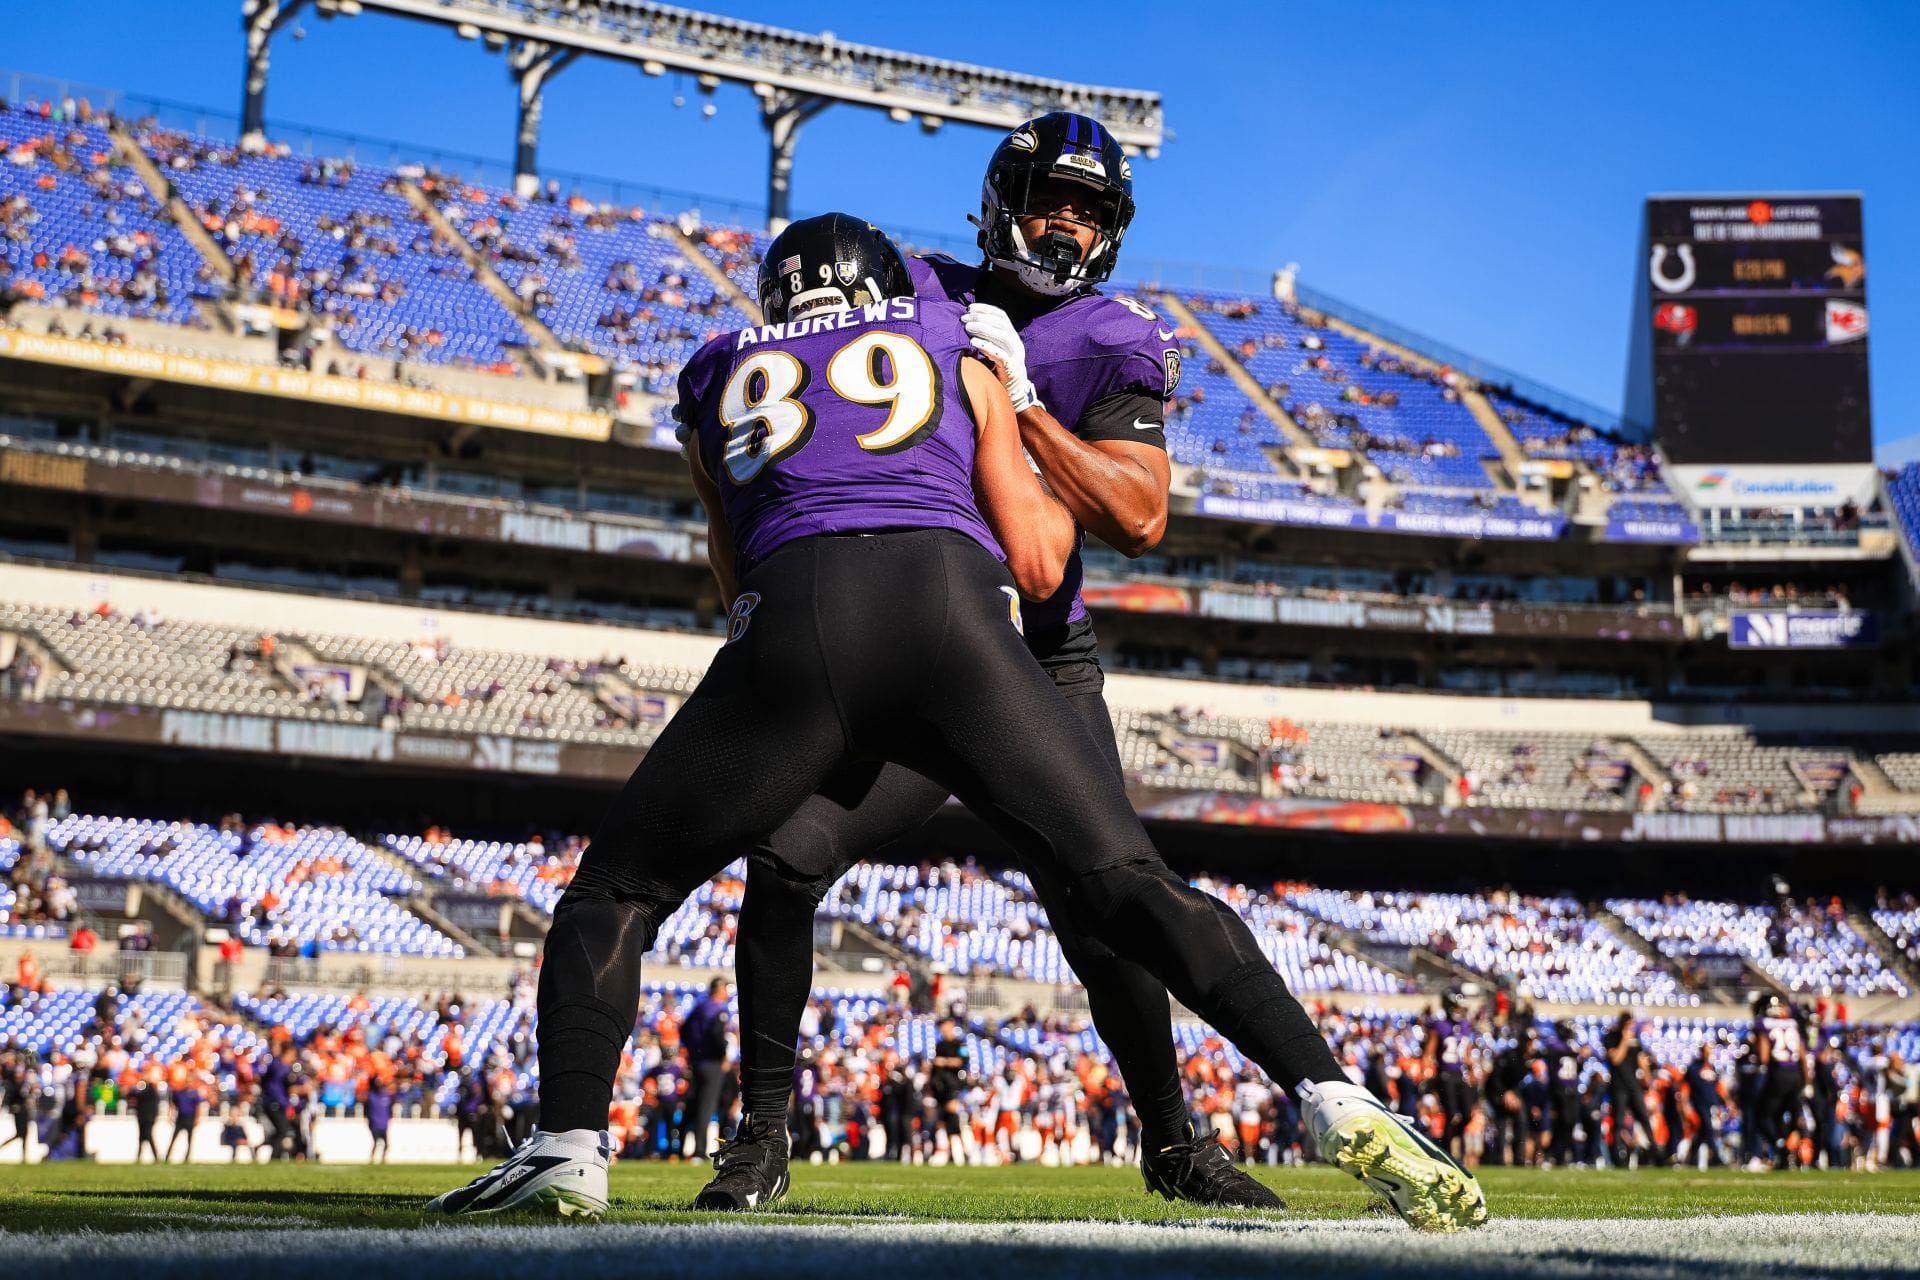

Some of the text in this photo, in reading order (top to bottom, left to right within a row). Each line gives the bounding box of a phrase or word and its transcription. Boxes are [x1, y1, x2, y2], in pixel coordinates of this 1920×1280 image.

[790, 264, 833, 294] 8 9
[736, 296, 915, 350] ANDREWS
[719, 330, 944, 486] 89
[500, 1168, 528, 1187] ALPHA
